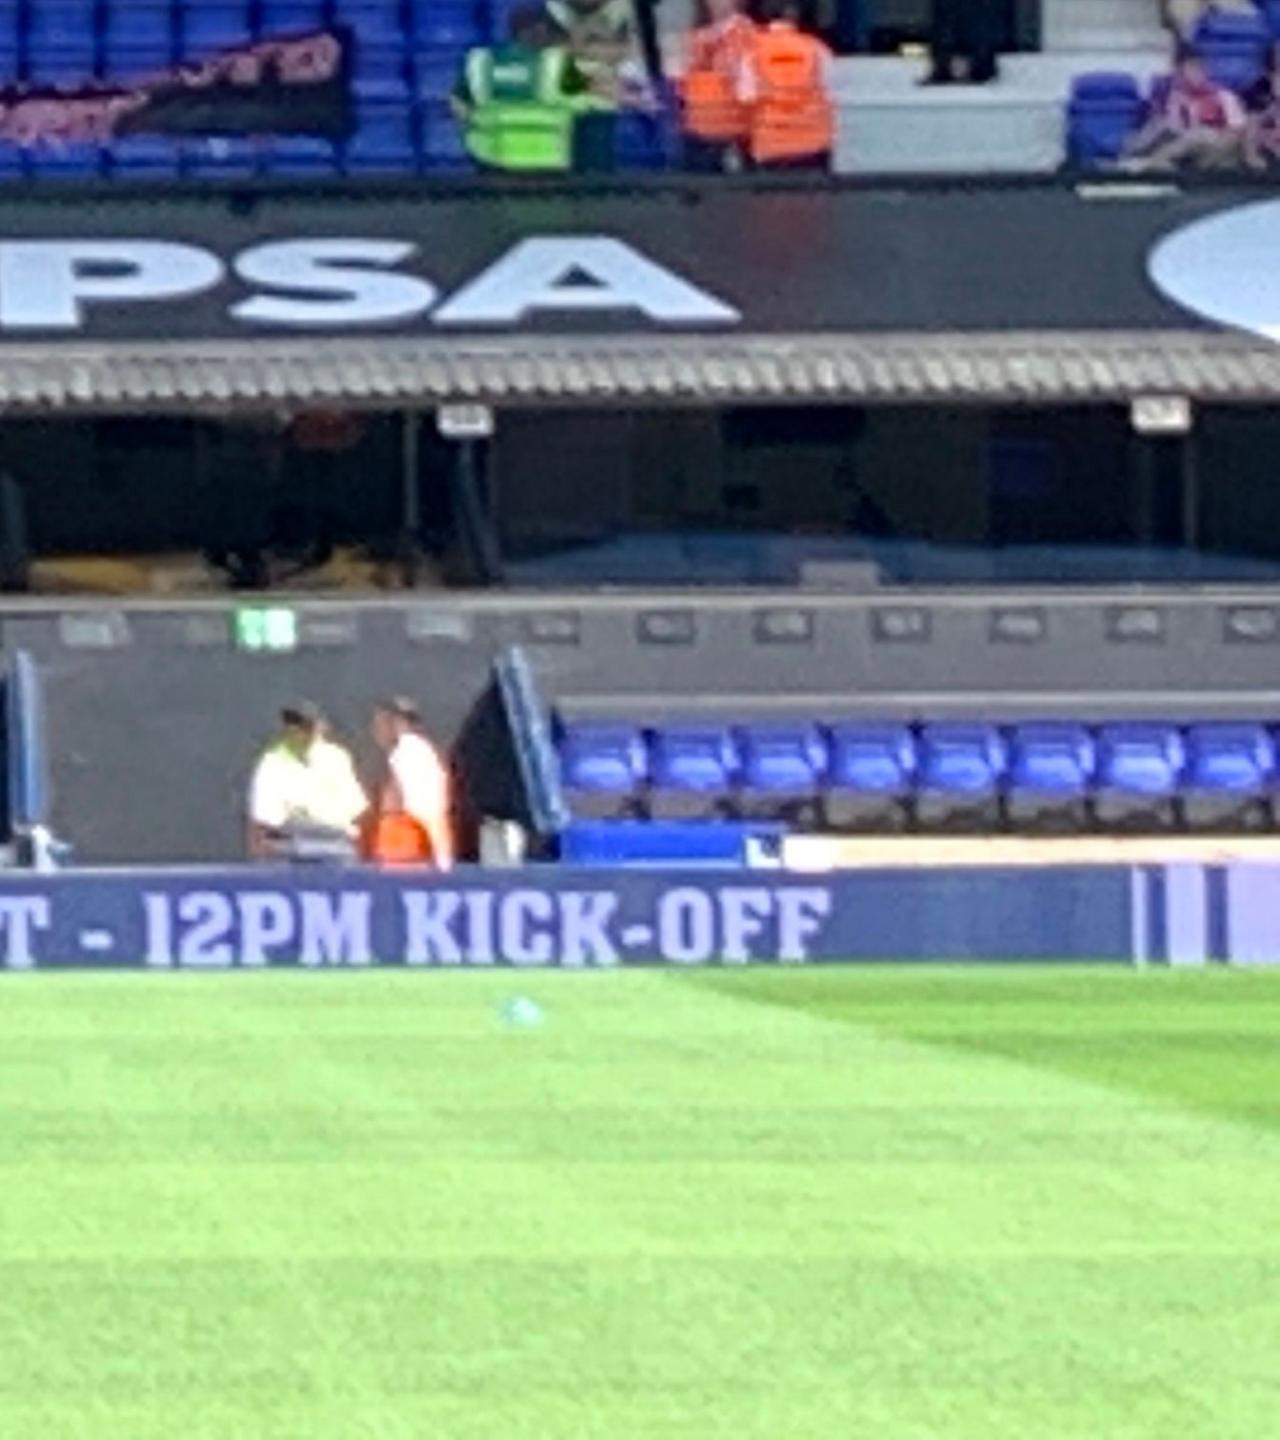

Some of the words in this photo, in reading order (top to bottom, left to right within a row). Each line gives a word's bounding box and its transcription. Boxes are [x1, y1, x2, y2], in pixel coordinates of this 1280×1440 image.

[80, 930, 113, 950] -
[144, 891, 372, 965] 12PM
[403, 887, 831, 964] KICK-OFF
